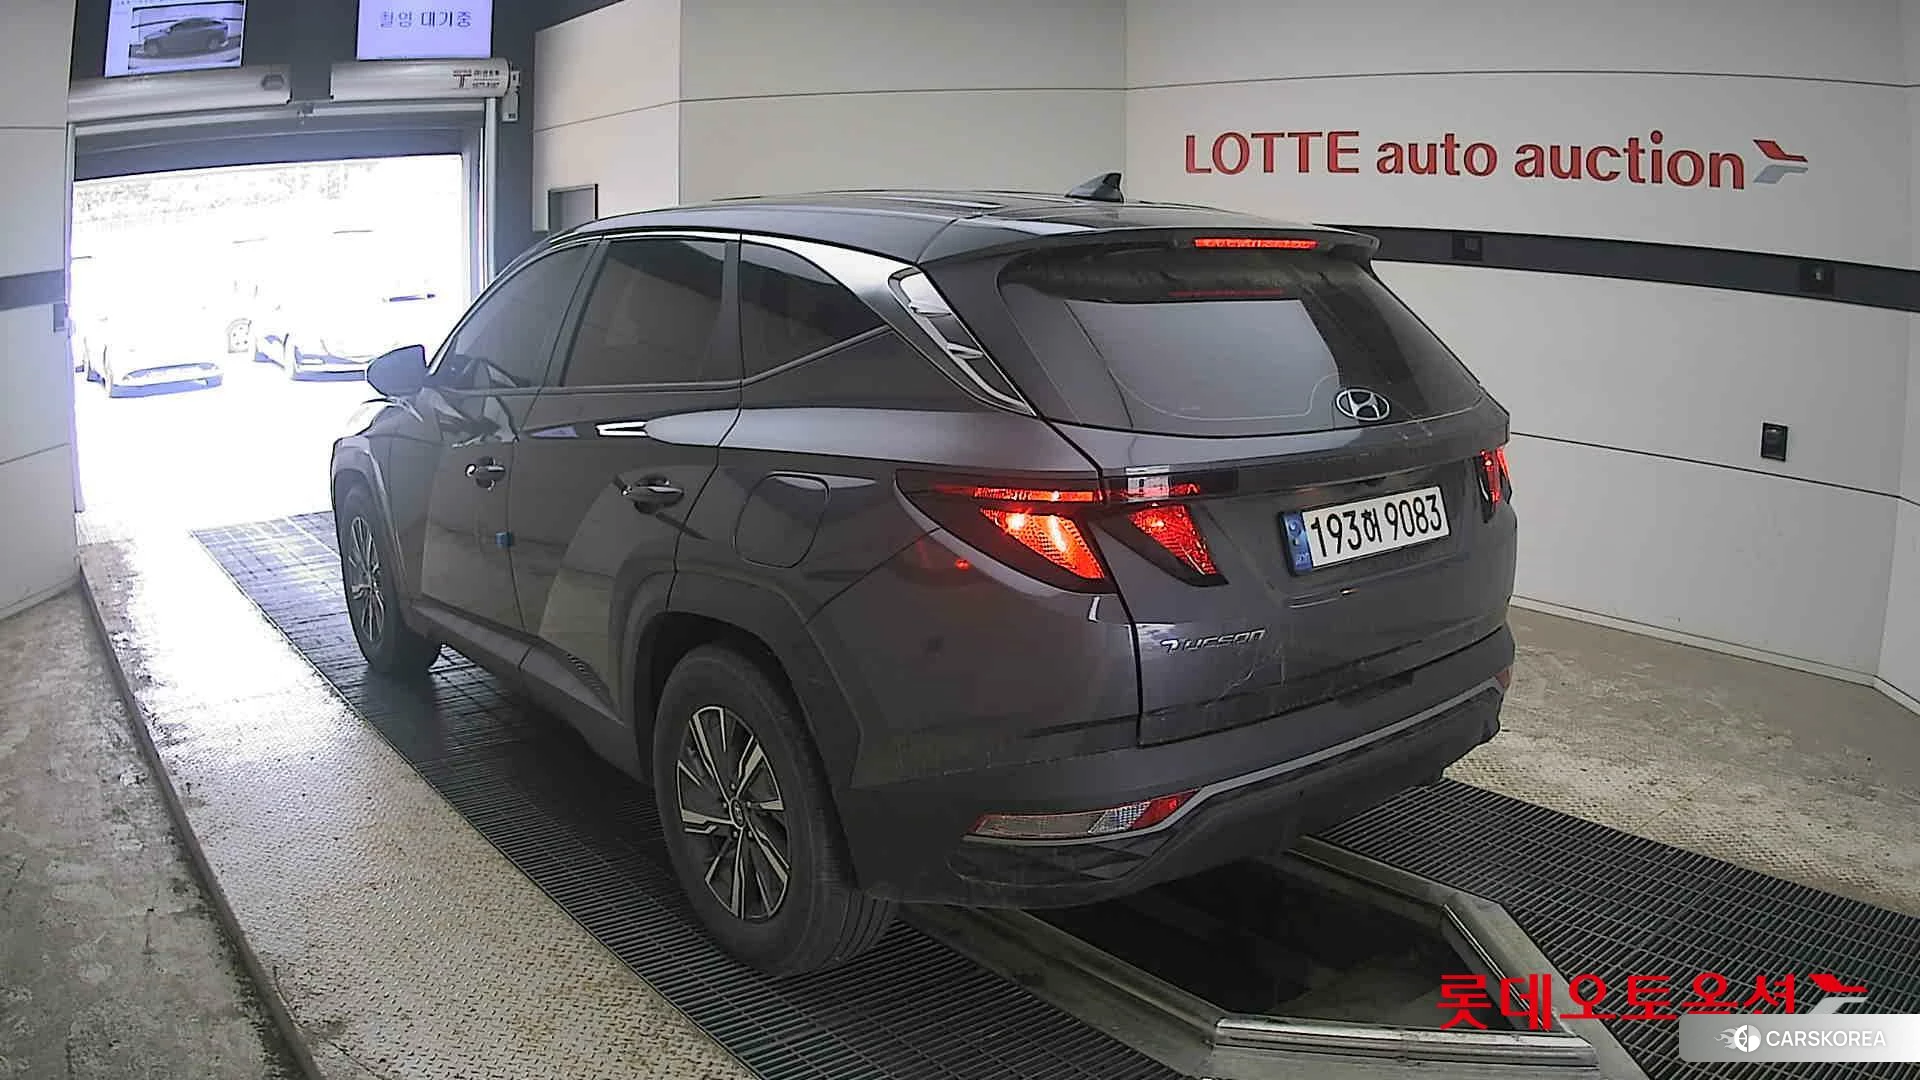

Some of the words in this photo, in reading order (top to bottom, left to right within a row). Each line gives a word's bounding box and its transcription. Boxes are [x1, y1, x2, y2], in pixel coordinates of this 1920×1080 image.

[420, 10, 472, 28] 대기중
[1185, 131, 1360, 175] LOTTE
[1376, 132, 1498, 178] auto
[1514, 130, 1745, 190] auction
[1310, 507, 1383, 558] 193허
[1384, 494, 1442, 541] 9083
